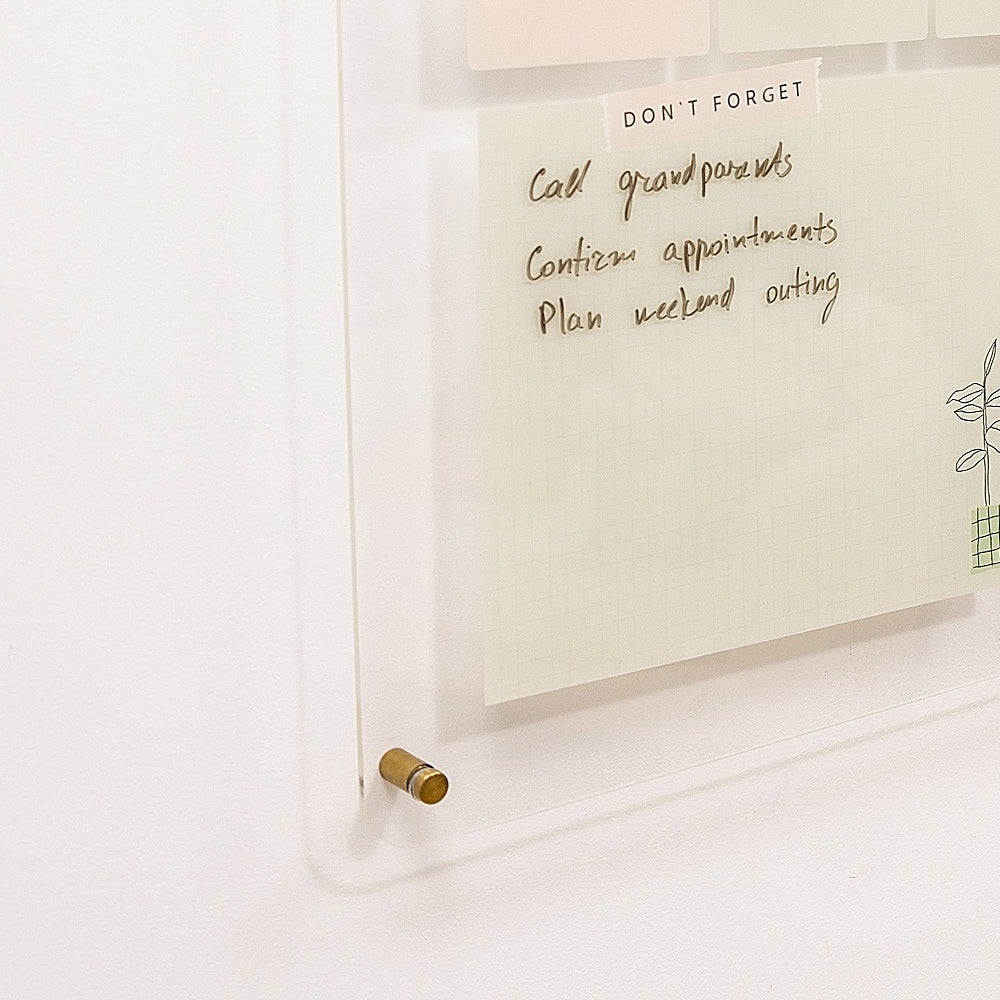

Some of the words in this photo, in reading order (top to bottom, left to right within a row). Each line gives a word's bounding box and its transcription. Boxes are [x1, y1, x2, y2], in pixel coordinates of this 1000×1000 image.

[713, 81, 804, 112] FORGET
[529, 160, 592, 201] Call
[618, 141, 793, 220] grandparents
[526, 237, 636, 281] Confirm
[663, 212, 839, 272] appointments
[538, 298, 602, 335] Plan
[635, 278, 735, 325] weekend
[766, 267, 840, 325] outing
